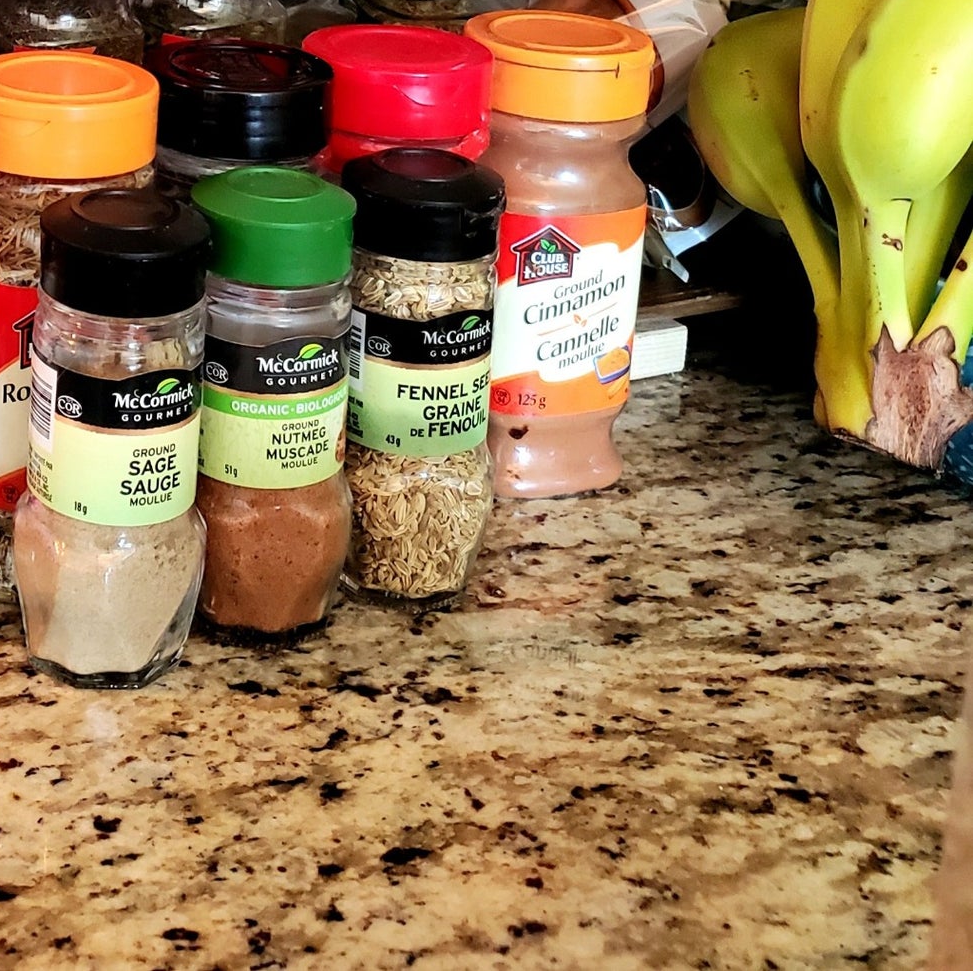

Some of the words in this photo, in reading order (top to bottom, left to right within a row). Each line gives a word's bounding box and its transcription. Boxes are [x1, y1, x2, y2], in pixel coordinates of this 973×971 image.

[530, 251, 565, 265] CLUB
[523, 262, 569, 280] HOUSE
[553, 269, 603, 300] Ground
[523, 274, 625, 325] Cinnamon
[421, 319, 491, 345] McCormick
[536, 315, 620, 363] Cannelle
[429, 340, 487, 358] GOURMET
[558, 342, 605, 369] moulue
[256, 349, 339, 373] McCormick
[266, 369, 334, 386] GOURMET
[397, 383, 469, 401] FENNEL
[472, 370, 490, 393] SEE
[3, 383, 31, 404] Ro
[112, 382, 194, 410] McCormick
[518, 393, 537, 406] 125
[538, 396, 547, 410] g
[121, 404, 190, 422] GOURMET
[231, 400, 289, 416] ORGANIC
[423, 395, 482, 420] GRAINE
[281, 419, 320, 431] GROUND
[410, 428, 425, 438] DE
[428, 408, 486, 438] FENOUIL
[271, 426, 327, 446] NUTMEG
[132, 443, 176, 458] GROUND
[266, 441, 329, 461] MUSCADE
[128, 454, 177, 476] SAGE
[281, 456, 319, 470] MOULUE
[120, 471, 181, 496] SAUGE
[129, 491, 172, 507] MOULUE
